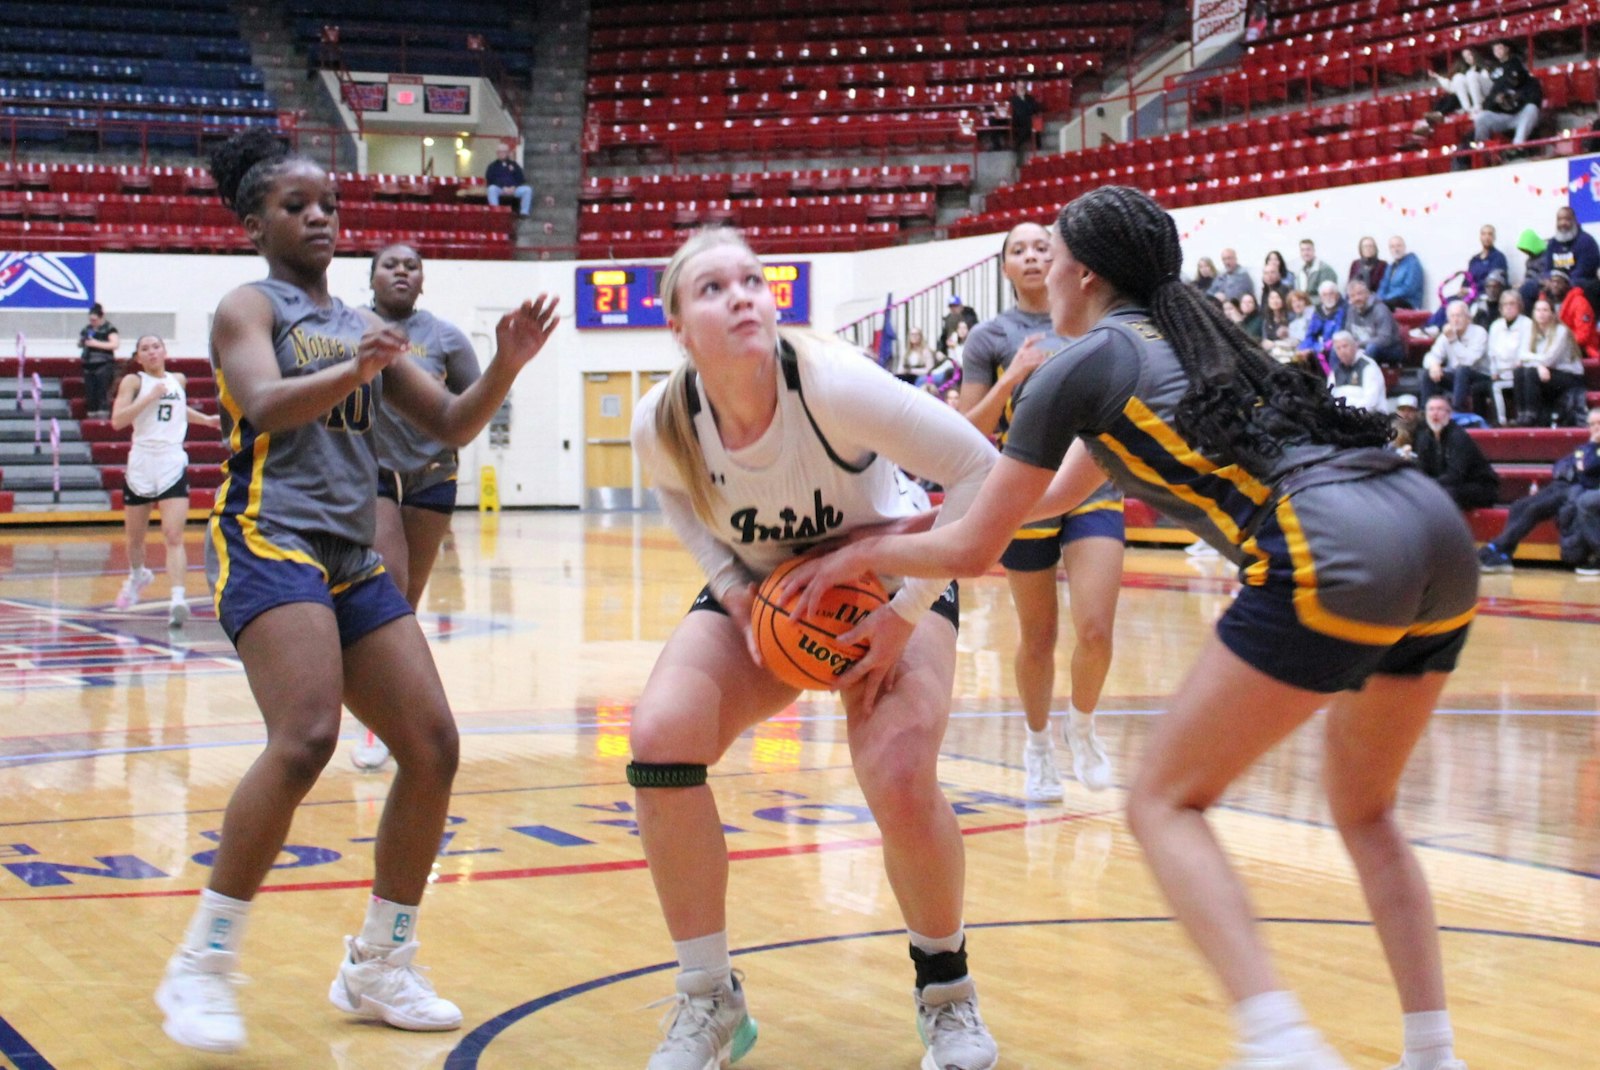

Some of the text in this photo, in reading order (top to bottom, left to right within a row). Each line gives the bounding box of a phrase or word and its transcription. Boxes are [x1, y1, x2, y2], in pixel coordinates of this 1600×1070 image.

[597, 285, 629, 312] 21
[289, 326, 345, 367] Notre
[157, 404, 173, 422] 13
[730, 488, 844, 543] Irish
[798, 633, 857, 677] lson
